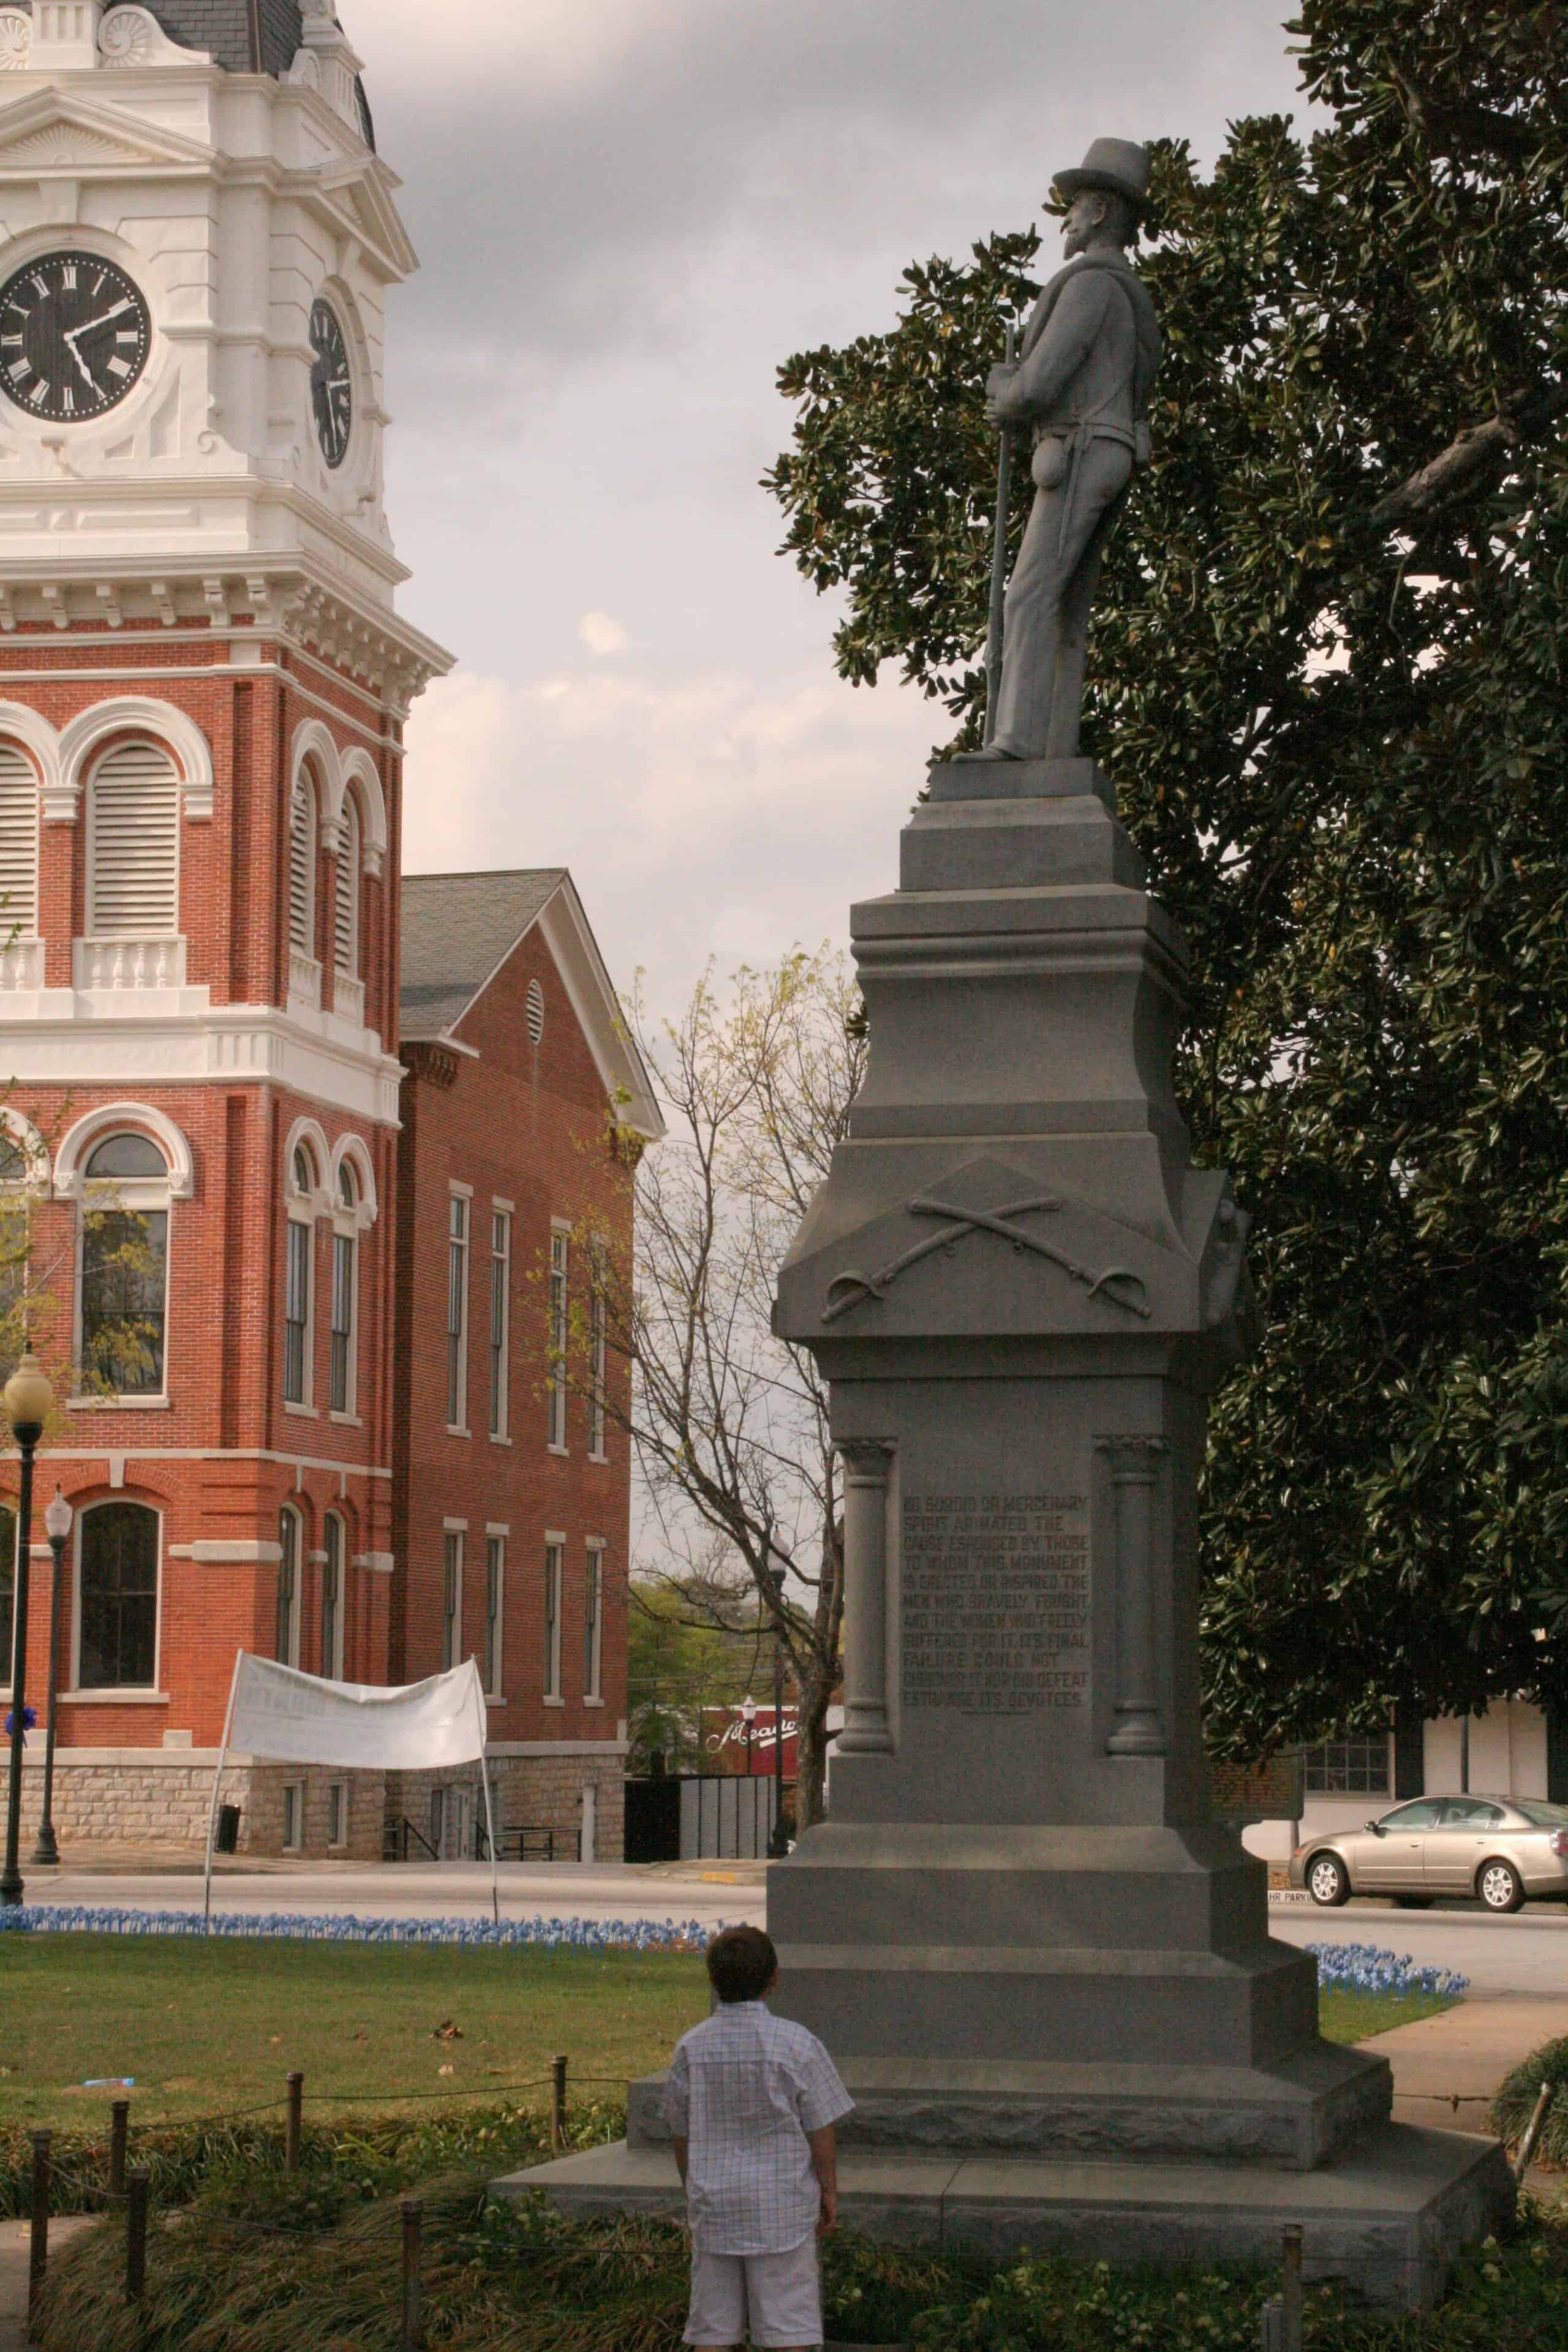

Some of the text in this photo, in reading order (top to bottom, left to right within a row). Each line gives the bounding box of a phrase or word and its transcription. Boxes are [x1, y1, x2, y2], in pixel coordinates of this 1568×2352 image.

[1035, 1516, 1065, 1531] THE
[1020, 1536, 1040, 1551] BY
[1045, 1536, 1090, 1551] THOSE
[905, 1555, 919, 1570] TO
[1009, 1555, 1088, 1570] MONUMENT
[1061, 1574, 1089, 1589] THE
[969, 1594, 1028, 1609] BRAVELY
[1035, 1594, 1089, 1609] FOUGHT
[932, 1613, 957, 1629] THE
[1037, 1672, 1088, 1687] DEFEAT
[1009, 1691, 1082, 1707] DEVOTEES
